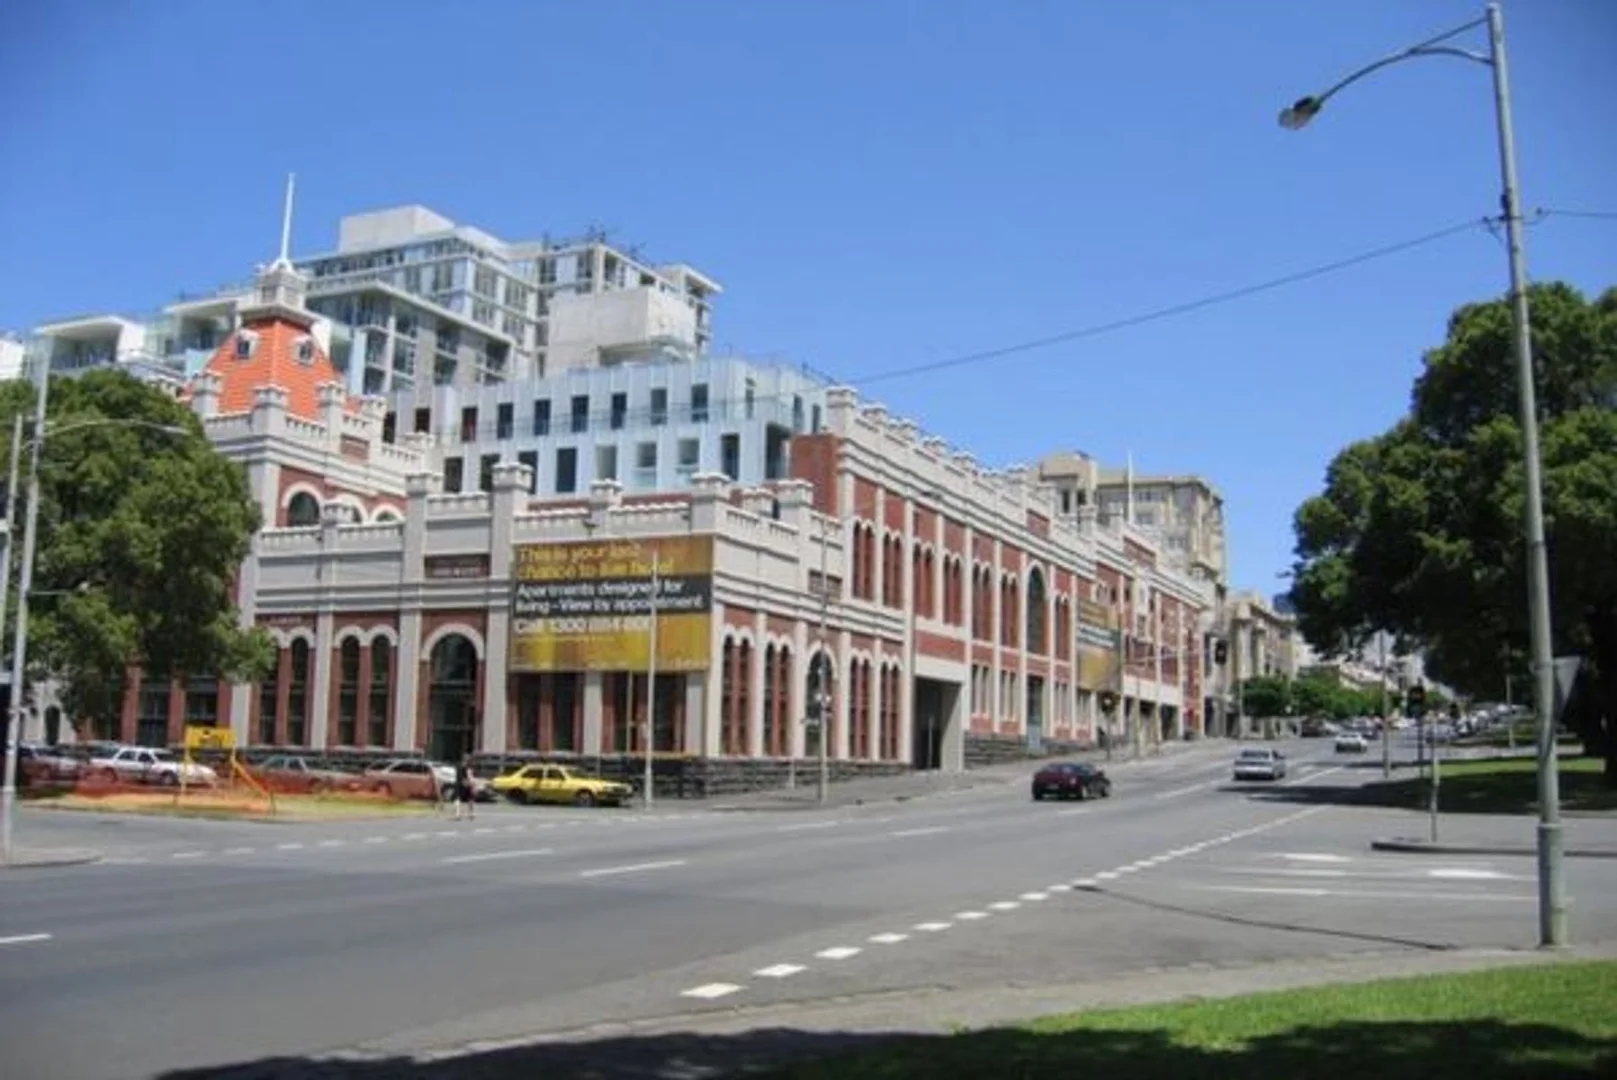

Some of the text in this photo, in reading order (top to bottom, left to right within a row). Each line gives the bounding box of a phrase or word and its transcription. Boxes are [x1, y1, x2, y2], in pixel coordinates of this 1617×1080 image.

[570, 547, 608, 564] your
[518, 582, 594, 599] Apartments
[664, 579, 683, 594] for
[515, 600, 549, 615] living
[559, 598, 592, 611] View
[594, 597, 611, 612] by
[613, 594, 703, 615] appotment
